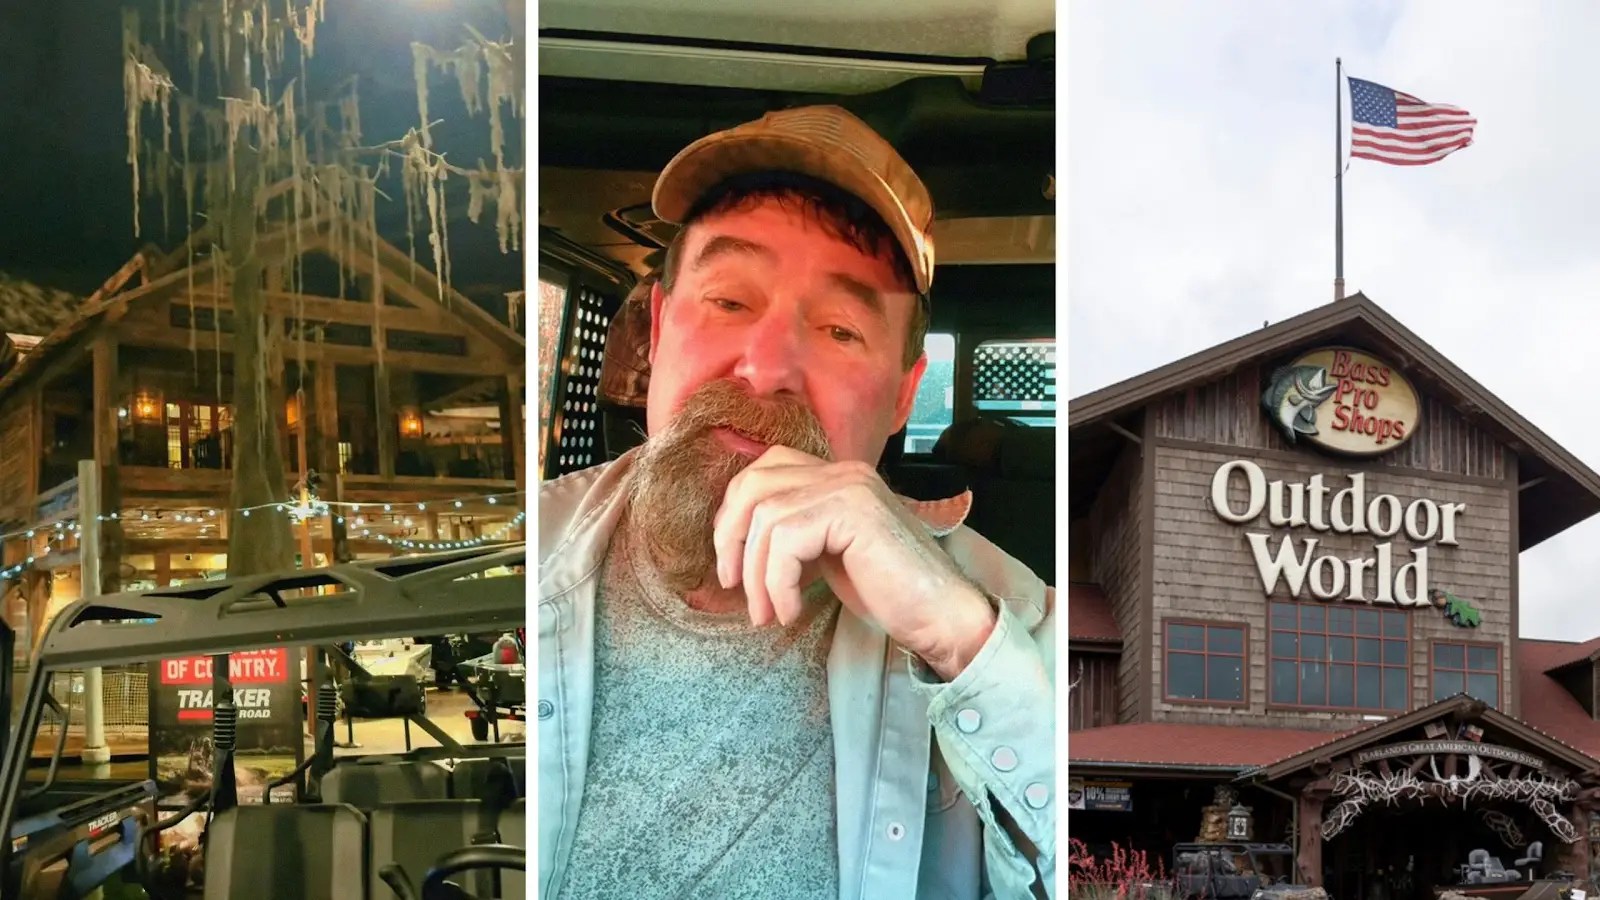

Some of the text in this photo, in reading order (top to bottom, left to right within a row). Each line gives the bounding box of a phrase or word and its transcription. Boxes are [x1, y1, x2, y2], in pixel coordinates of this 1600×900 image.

[1329, 350, 1391, 387] Bass
[1333, 378, 1380, 410] Pro
[1331, 404, 1408, 445] Shops
[1211, 459, 1466, 546] Outdoor
[1245, 532, 1431, 607] World
[167, 658, 280, 679] OF CONTRY.
[177, 688, 271, 709] TRAKER
[238, 709, 271, 719] ROAD
[1408, 743, 1436, 752] GREAT
[1437, 743, 1478, 752] AMERICAN
[1479, 744, 1519, 760] OUTDOOR
